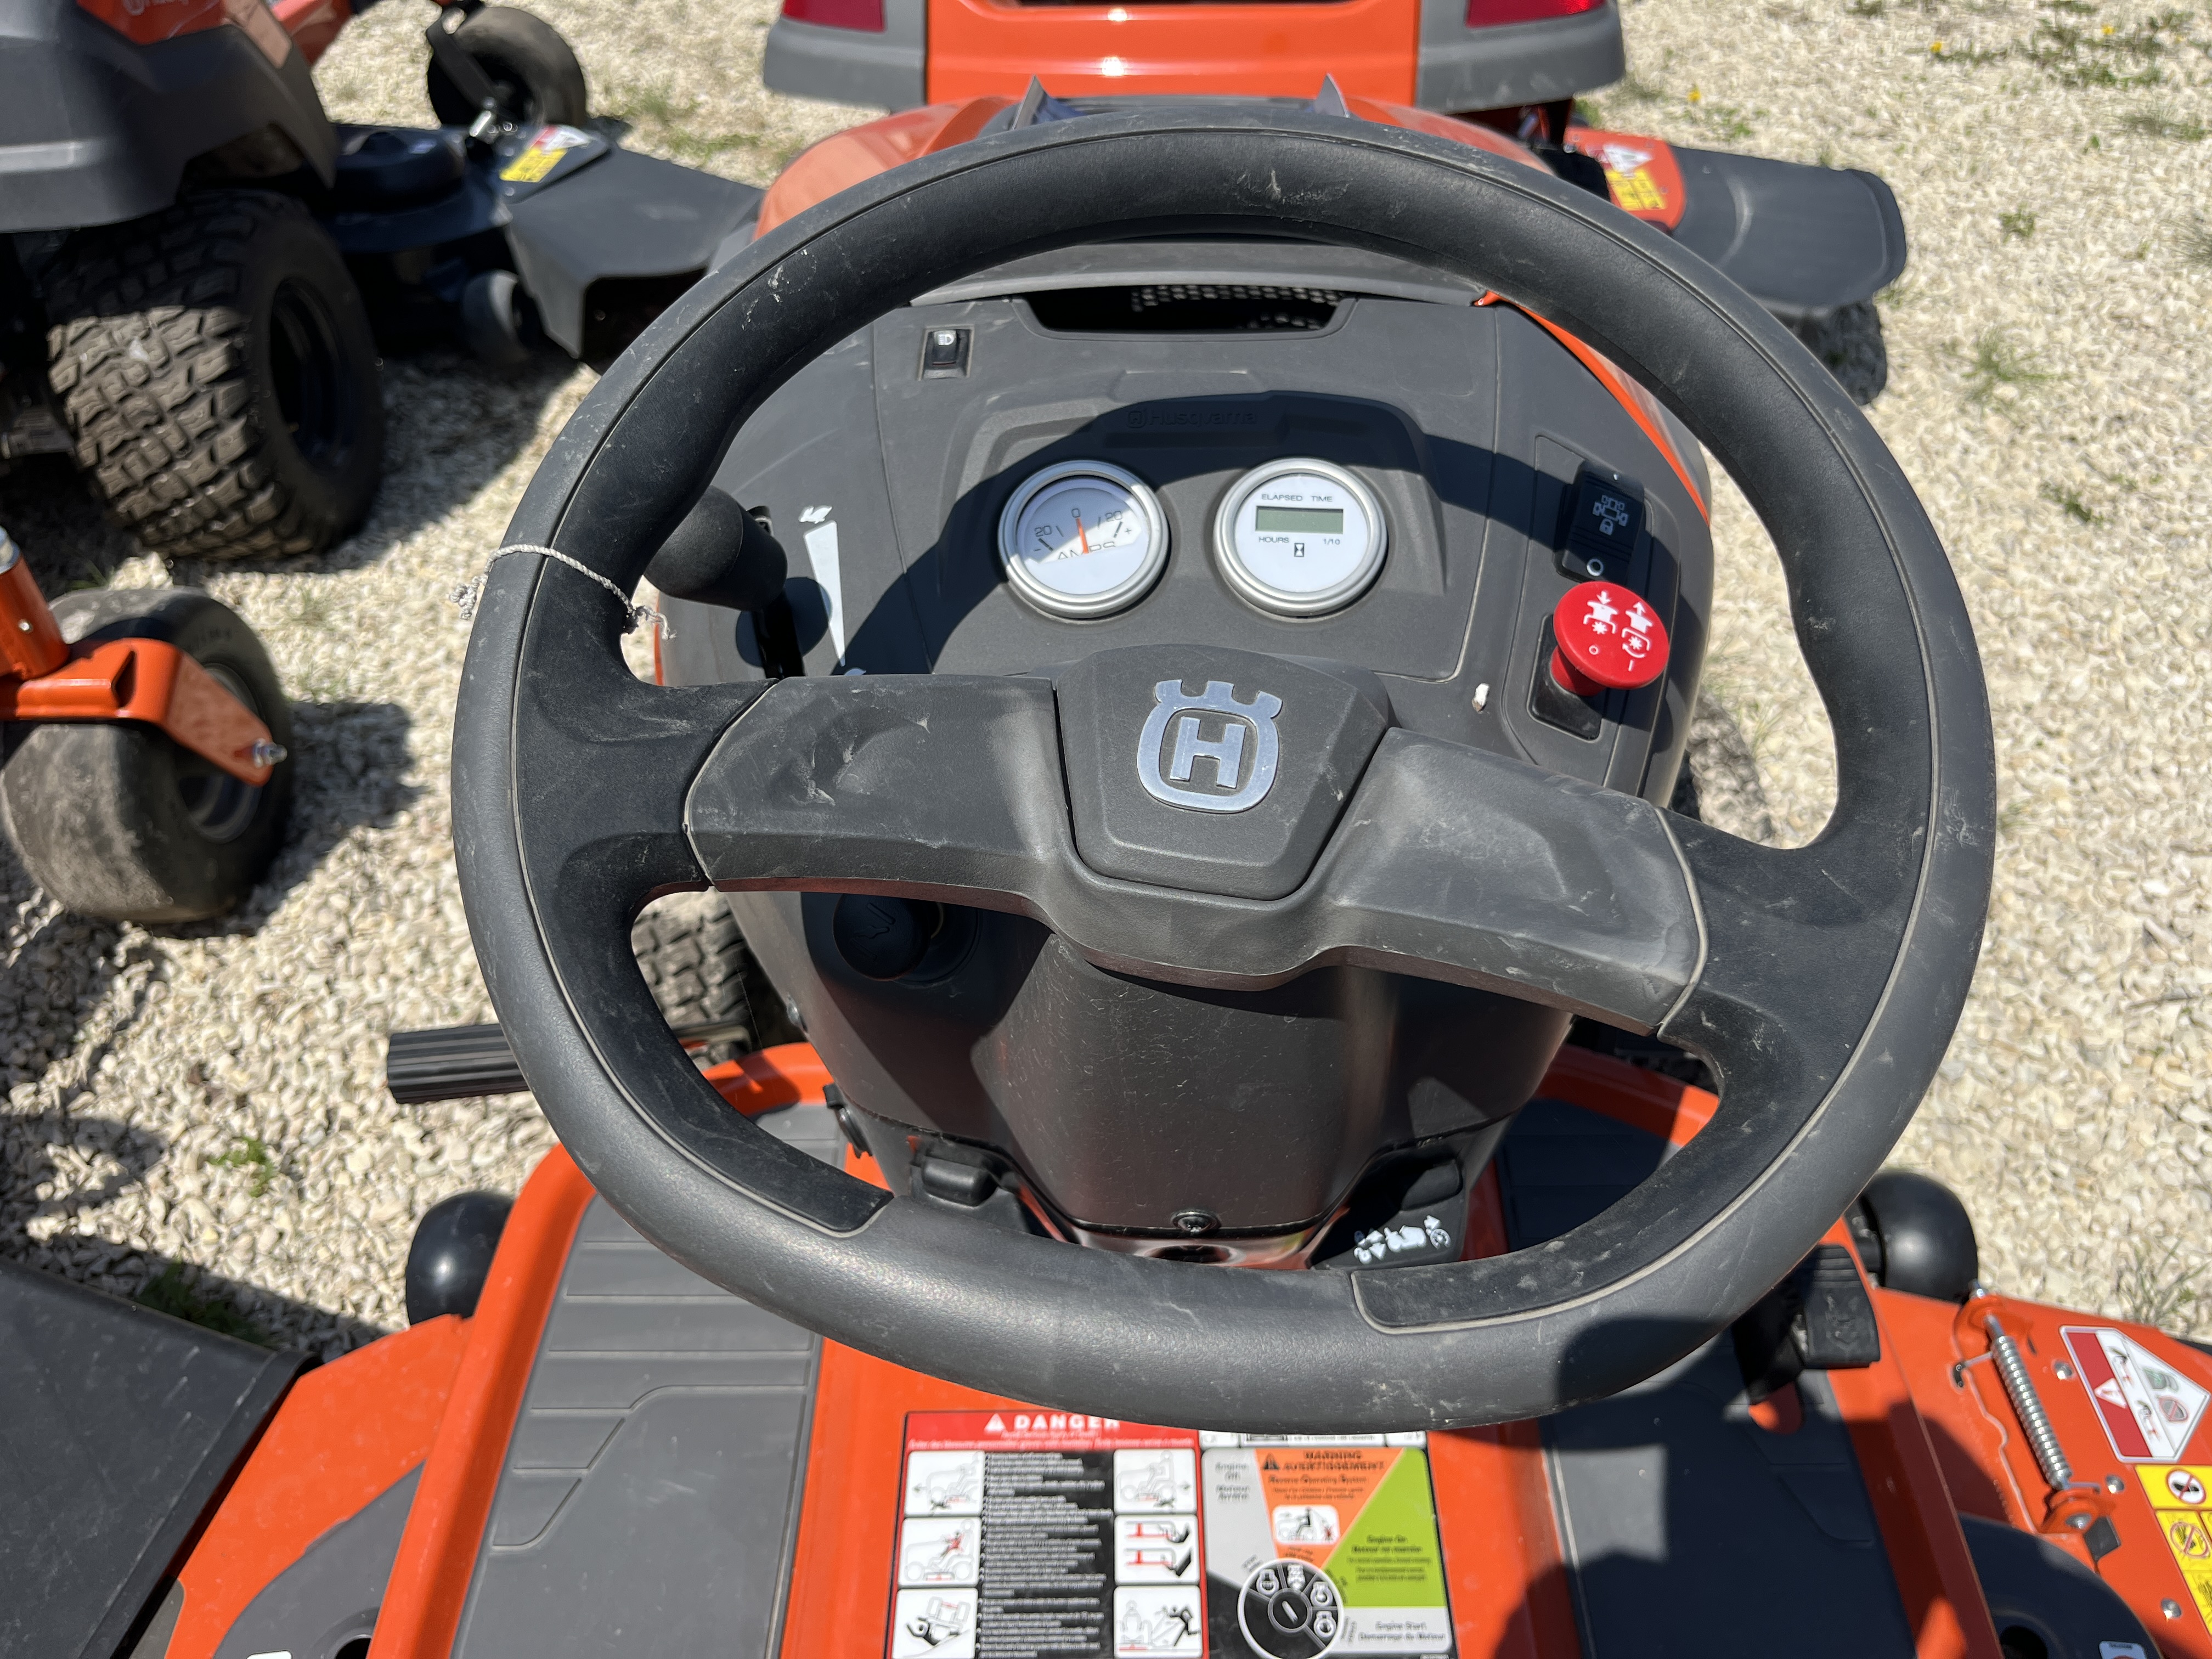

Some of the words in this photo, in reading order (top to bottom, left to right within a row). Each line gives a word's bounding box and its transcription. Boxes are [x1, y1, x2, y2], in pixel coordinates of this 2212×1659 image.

[1149, 411, 1257, 427] Husqvarna
[1071, 508, 1081, 518] 0
[1105, 510, 1123, 522] 20
[1034, 525, 1052, 537] 20
[1014, 1414, 1120, 1431] DANGER
